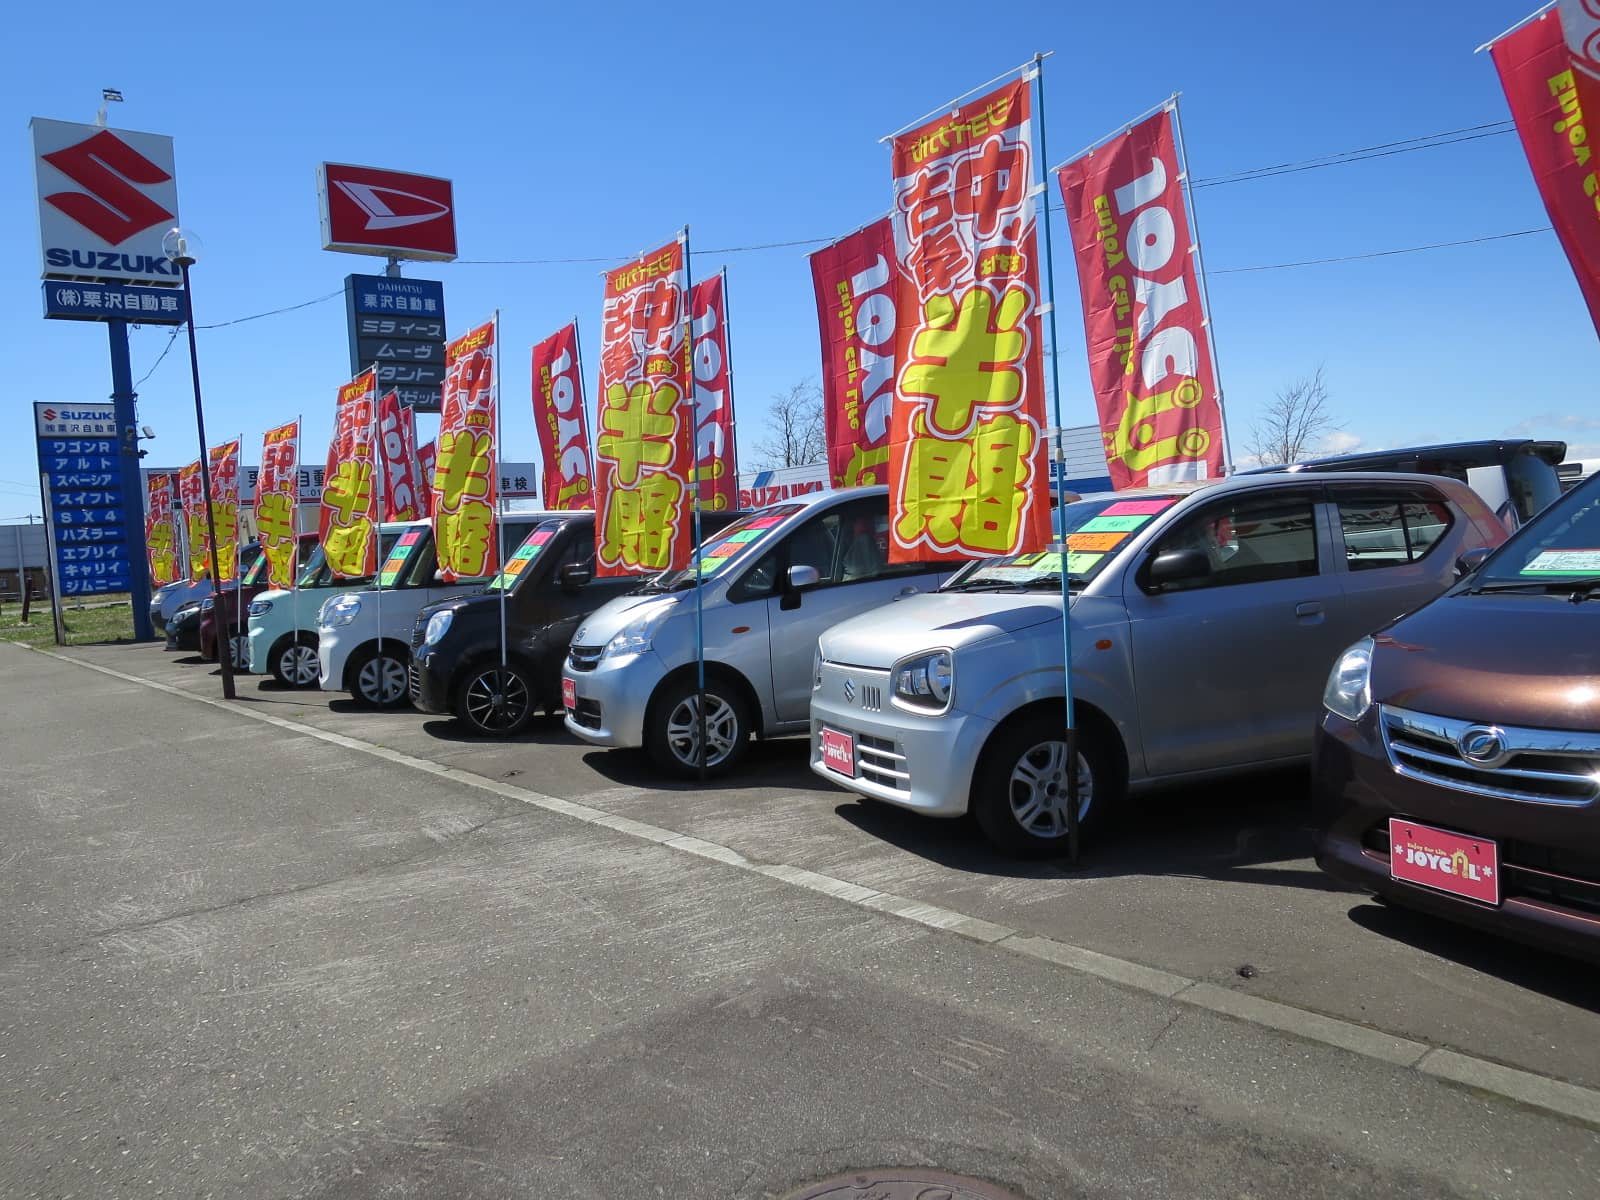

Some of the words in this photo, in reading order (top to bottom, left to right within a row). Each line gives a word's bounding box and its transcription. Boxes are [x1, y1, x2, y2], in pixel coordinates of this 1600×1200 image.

[46, 248, 181, 276] SUZUKI
[377, 282, 423, 294] DAIHATSU
[376, 343, 433, 359] ムーヴ
[379, 366, 435, 382] タント
[60, 411, 113, 420] SUZUK
[53, 441, 110, 453] ワゴンR
[55, 458, 112, 470] アルト
[56, 474, 112, 487] スペーシア
[59, 492, 116, 505] スイフト
[62, 528, 118, 541] ハスラー
[66, 580, 122, 593] ジムニー
